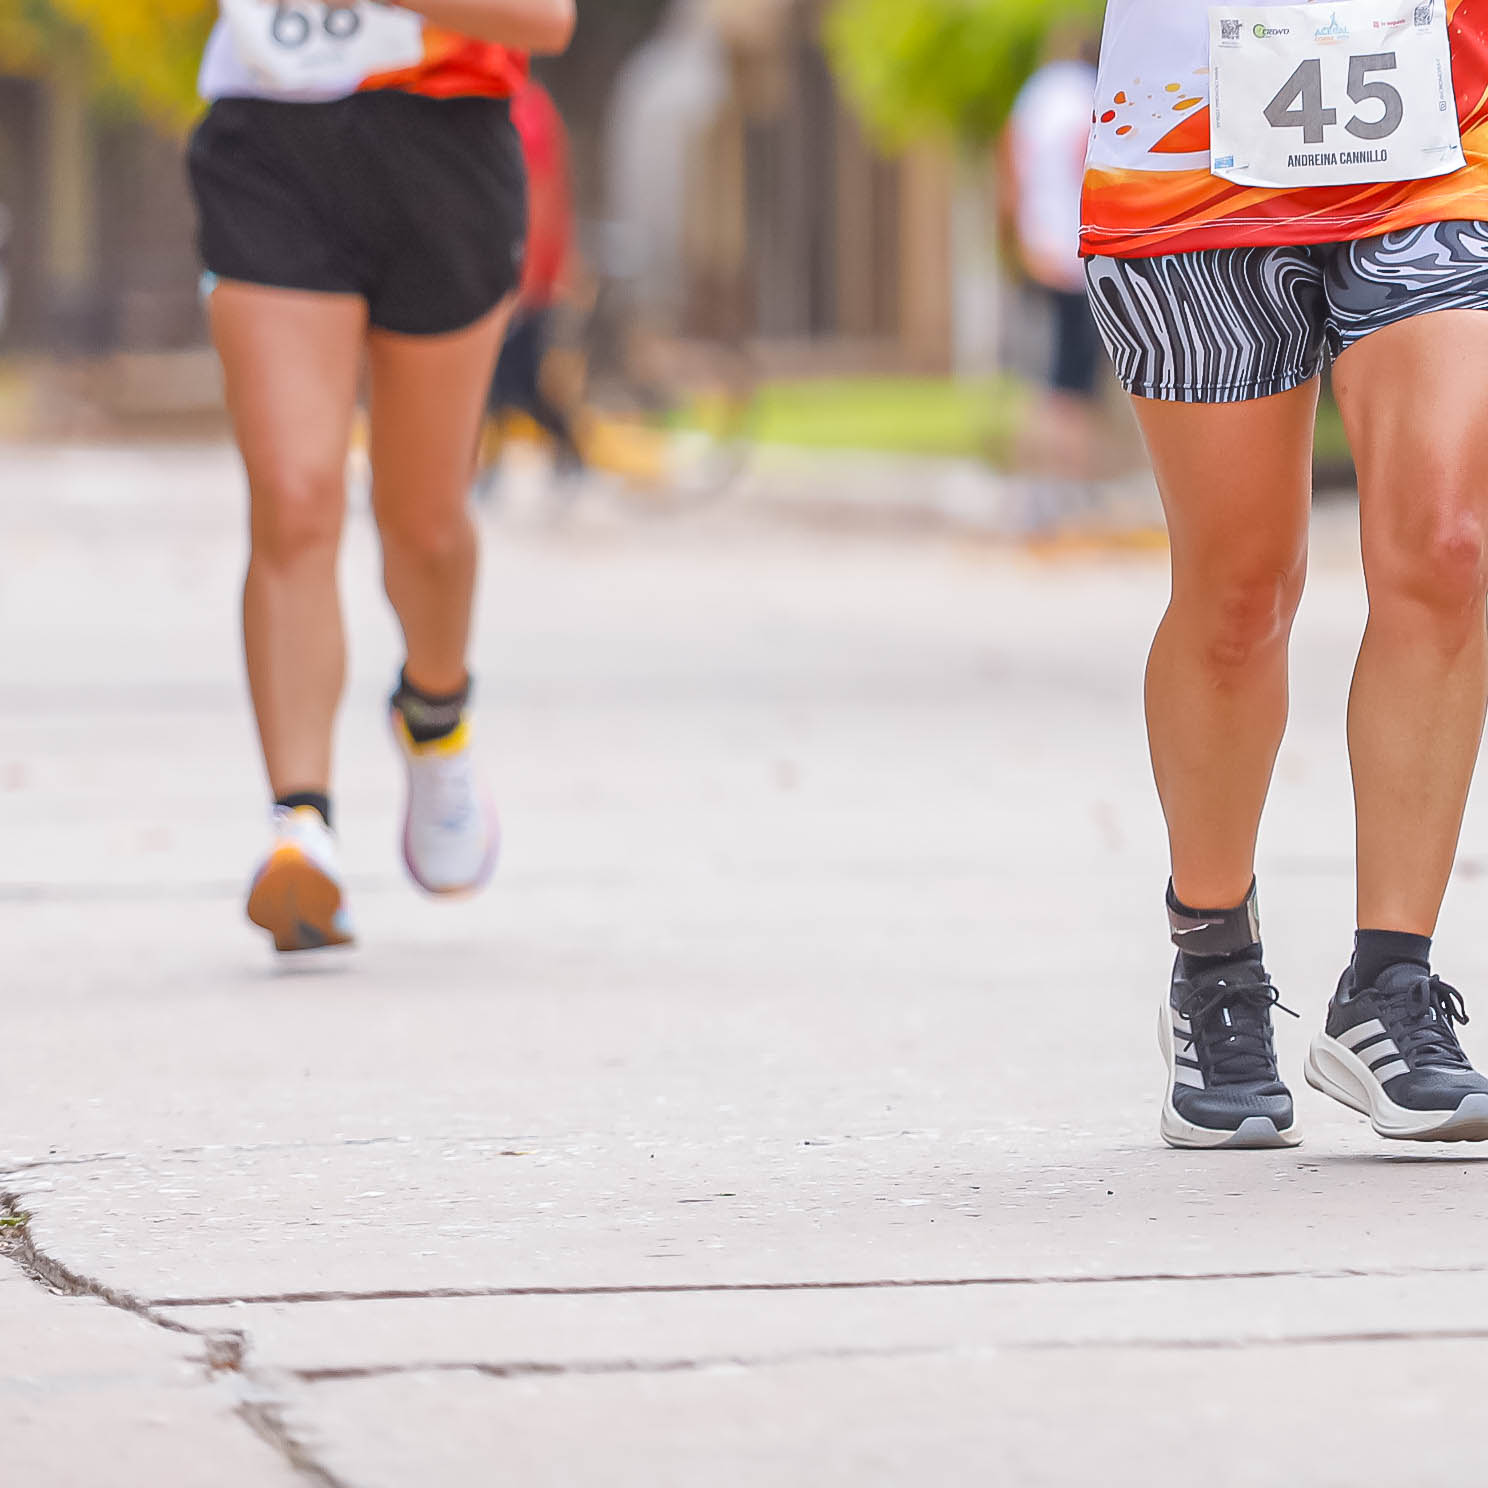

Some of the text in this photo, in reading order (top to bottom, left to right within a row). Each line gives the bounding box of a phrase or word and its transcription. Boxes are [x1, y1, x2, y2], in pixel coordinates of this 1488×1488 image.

[1263, 52, 1404, 144] 45
[1287, 148, 1388, 168] ANDREINA CANNILLO
